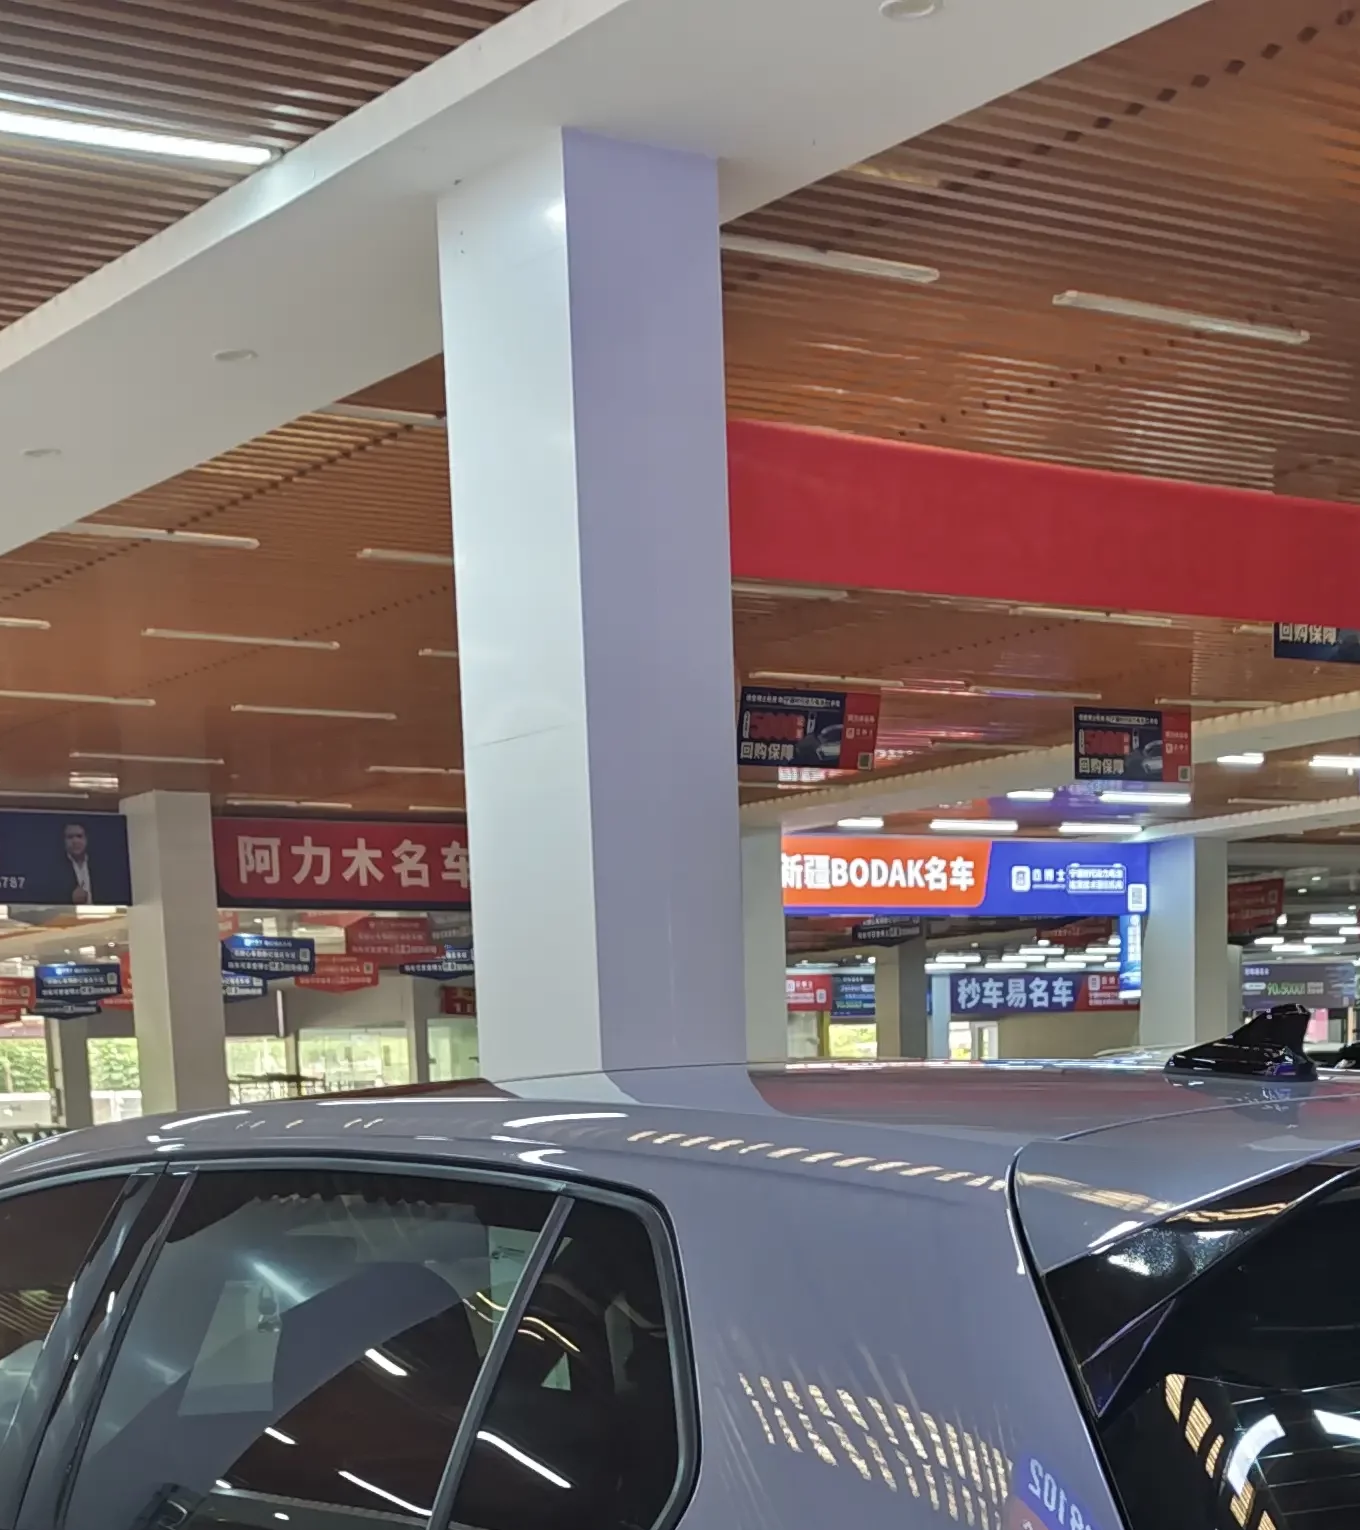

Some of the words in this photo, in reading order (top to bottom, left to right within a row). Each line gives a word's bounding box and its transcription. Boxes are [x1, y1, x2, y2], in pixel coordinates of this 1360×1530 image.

[237, 835, 471, 889] 阿力木名车
[957, 976, 1074, 1009] 秒车易名车
